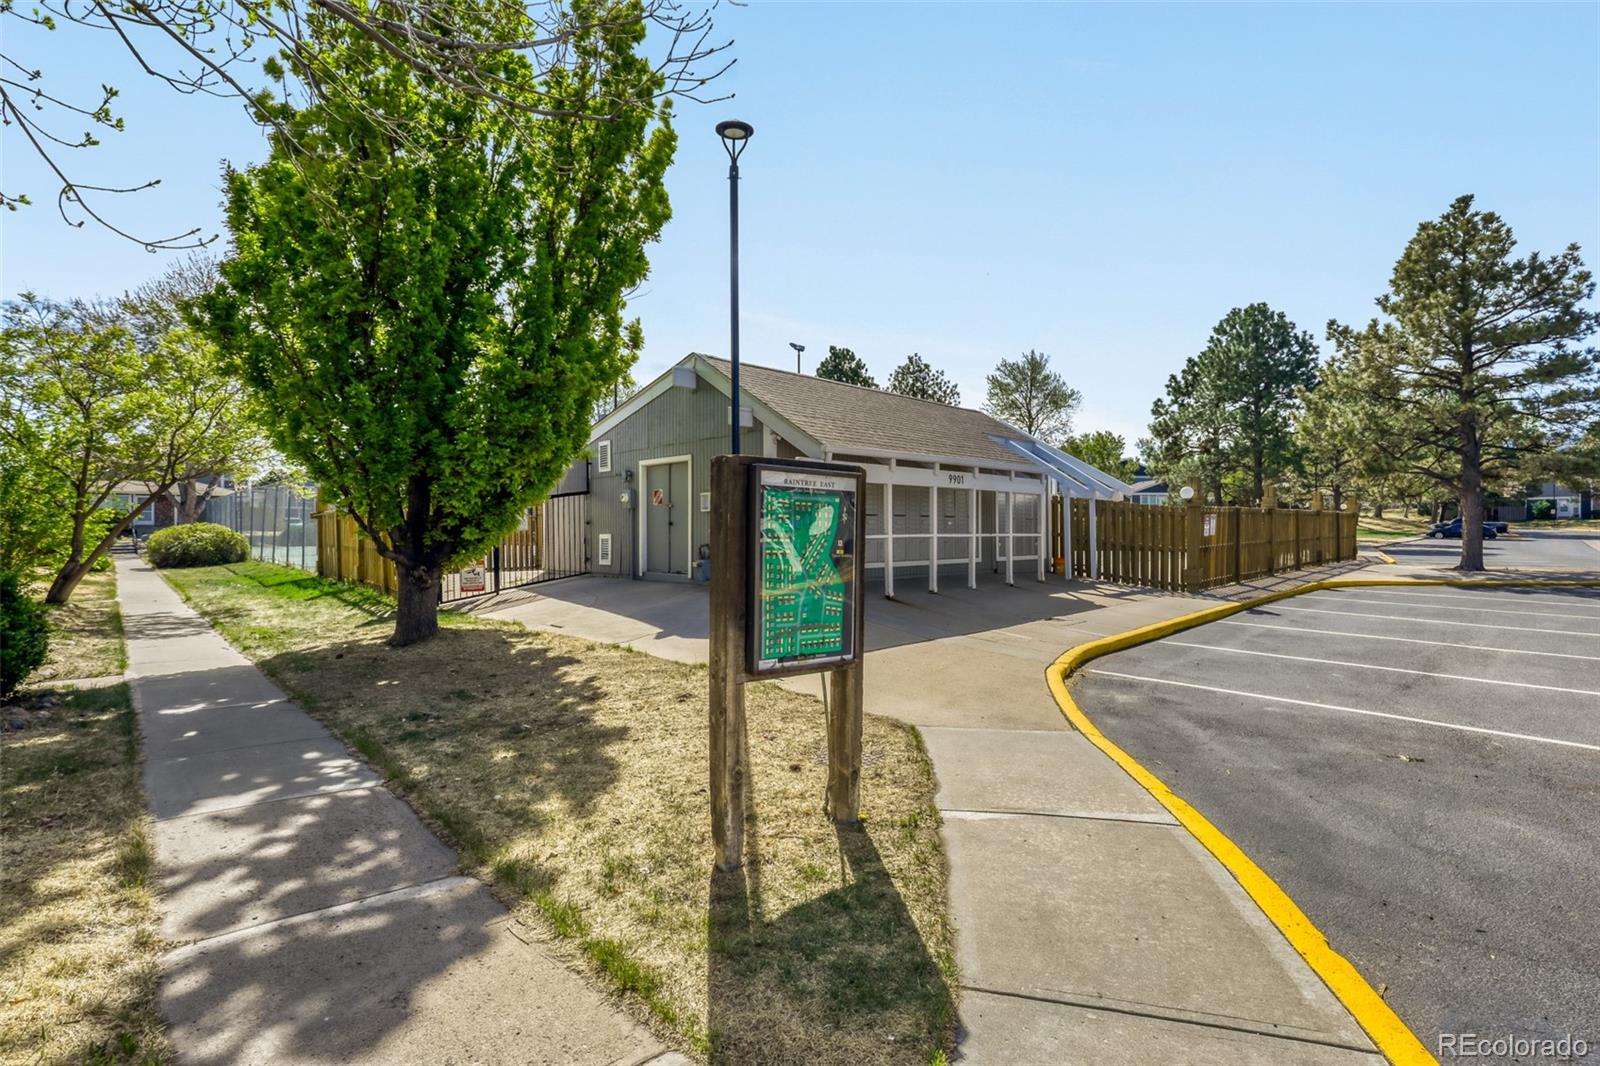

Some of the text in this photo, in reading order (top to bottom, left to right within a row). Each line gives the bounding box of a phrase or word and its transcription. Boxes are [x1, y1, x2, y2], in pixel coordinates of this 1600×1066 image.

[783, 478, 836, 489] RAINTREE EAST
[948, 474, 964, 485] 9901
